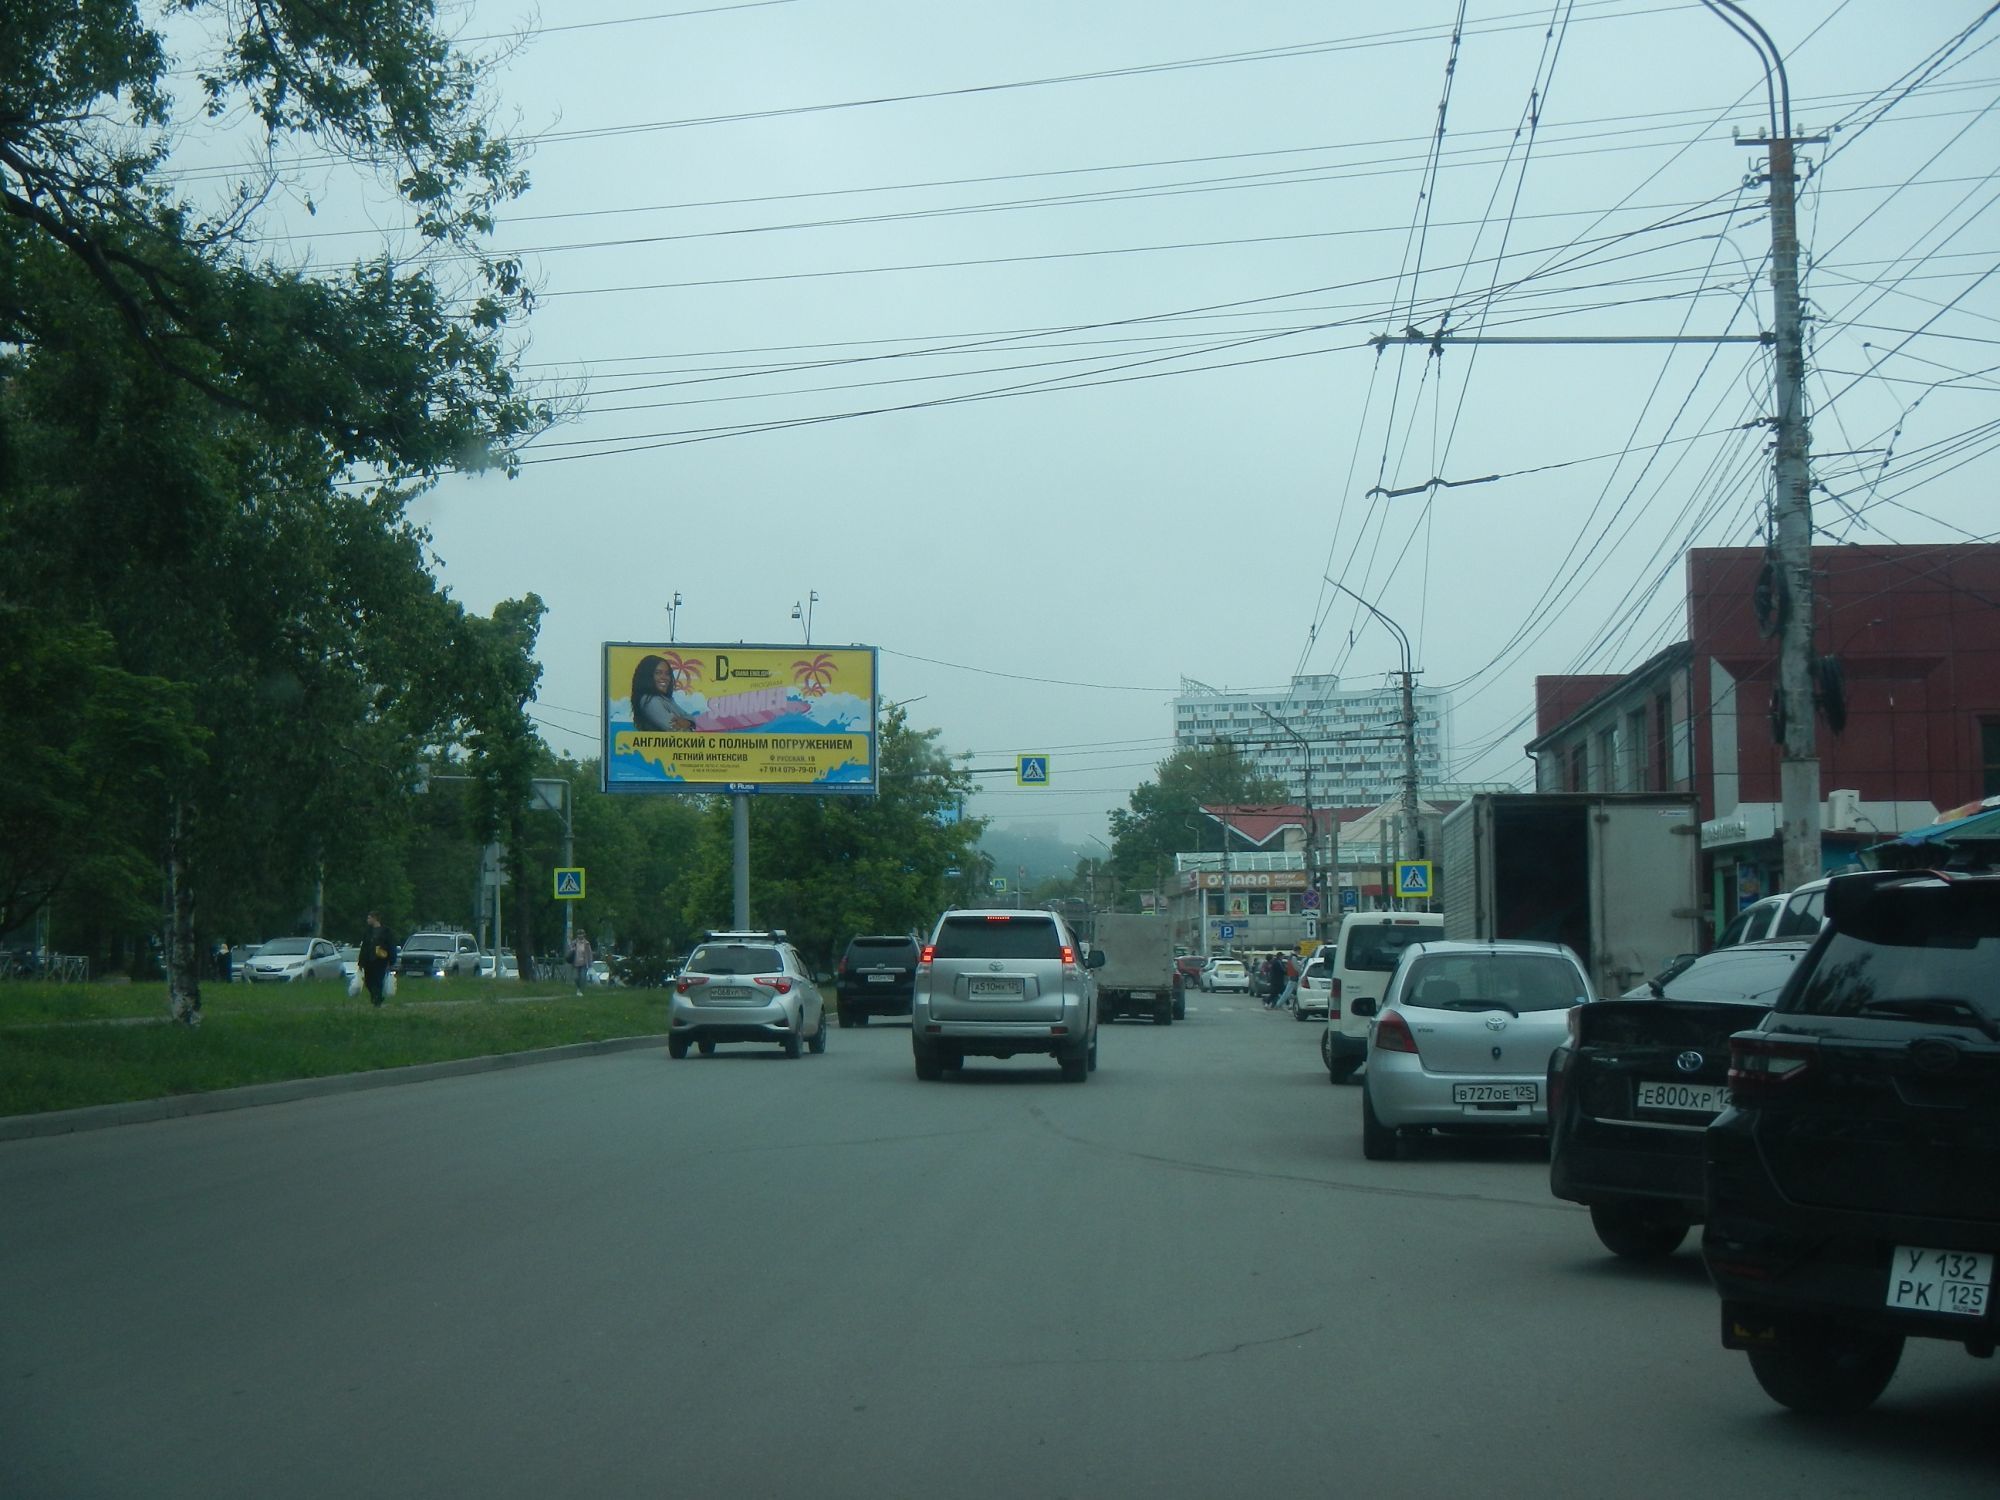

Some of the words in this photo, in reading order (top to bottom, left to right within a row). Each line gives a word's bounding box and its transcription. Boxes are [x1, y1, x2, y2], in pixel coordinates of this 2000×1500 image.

[633, 736, 705, 748] АНГЛИЙСКИЙ
[708, 738, 716, 749] С
[719, 738, 768, 749] ПОЛНЫМ
[771, 739, 853, 750] ПОГРУЖЕНИЕМ
[672, 752, 704, 761] ЛЕТНИЙ
[706, 753, 748, 762] ИНТЕНСИВ
[1514, 1086, 1532, 1096] 125
[1936, 1254, 1977, 1280] 132
[1948, 1285, 1984, 1305] 125
